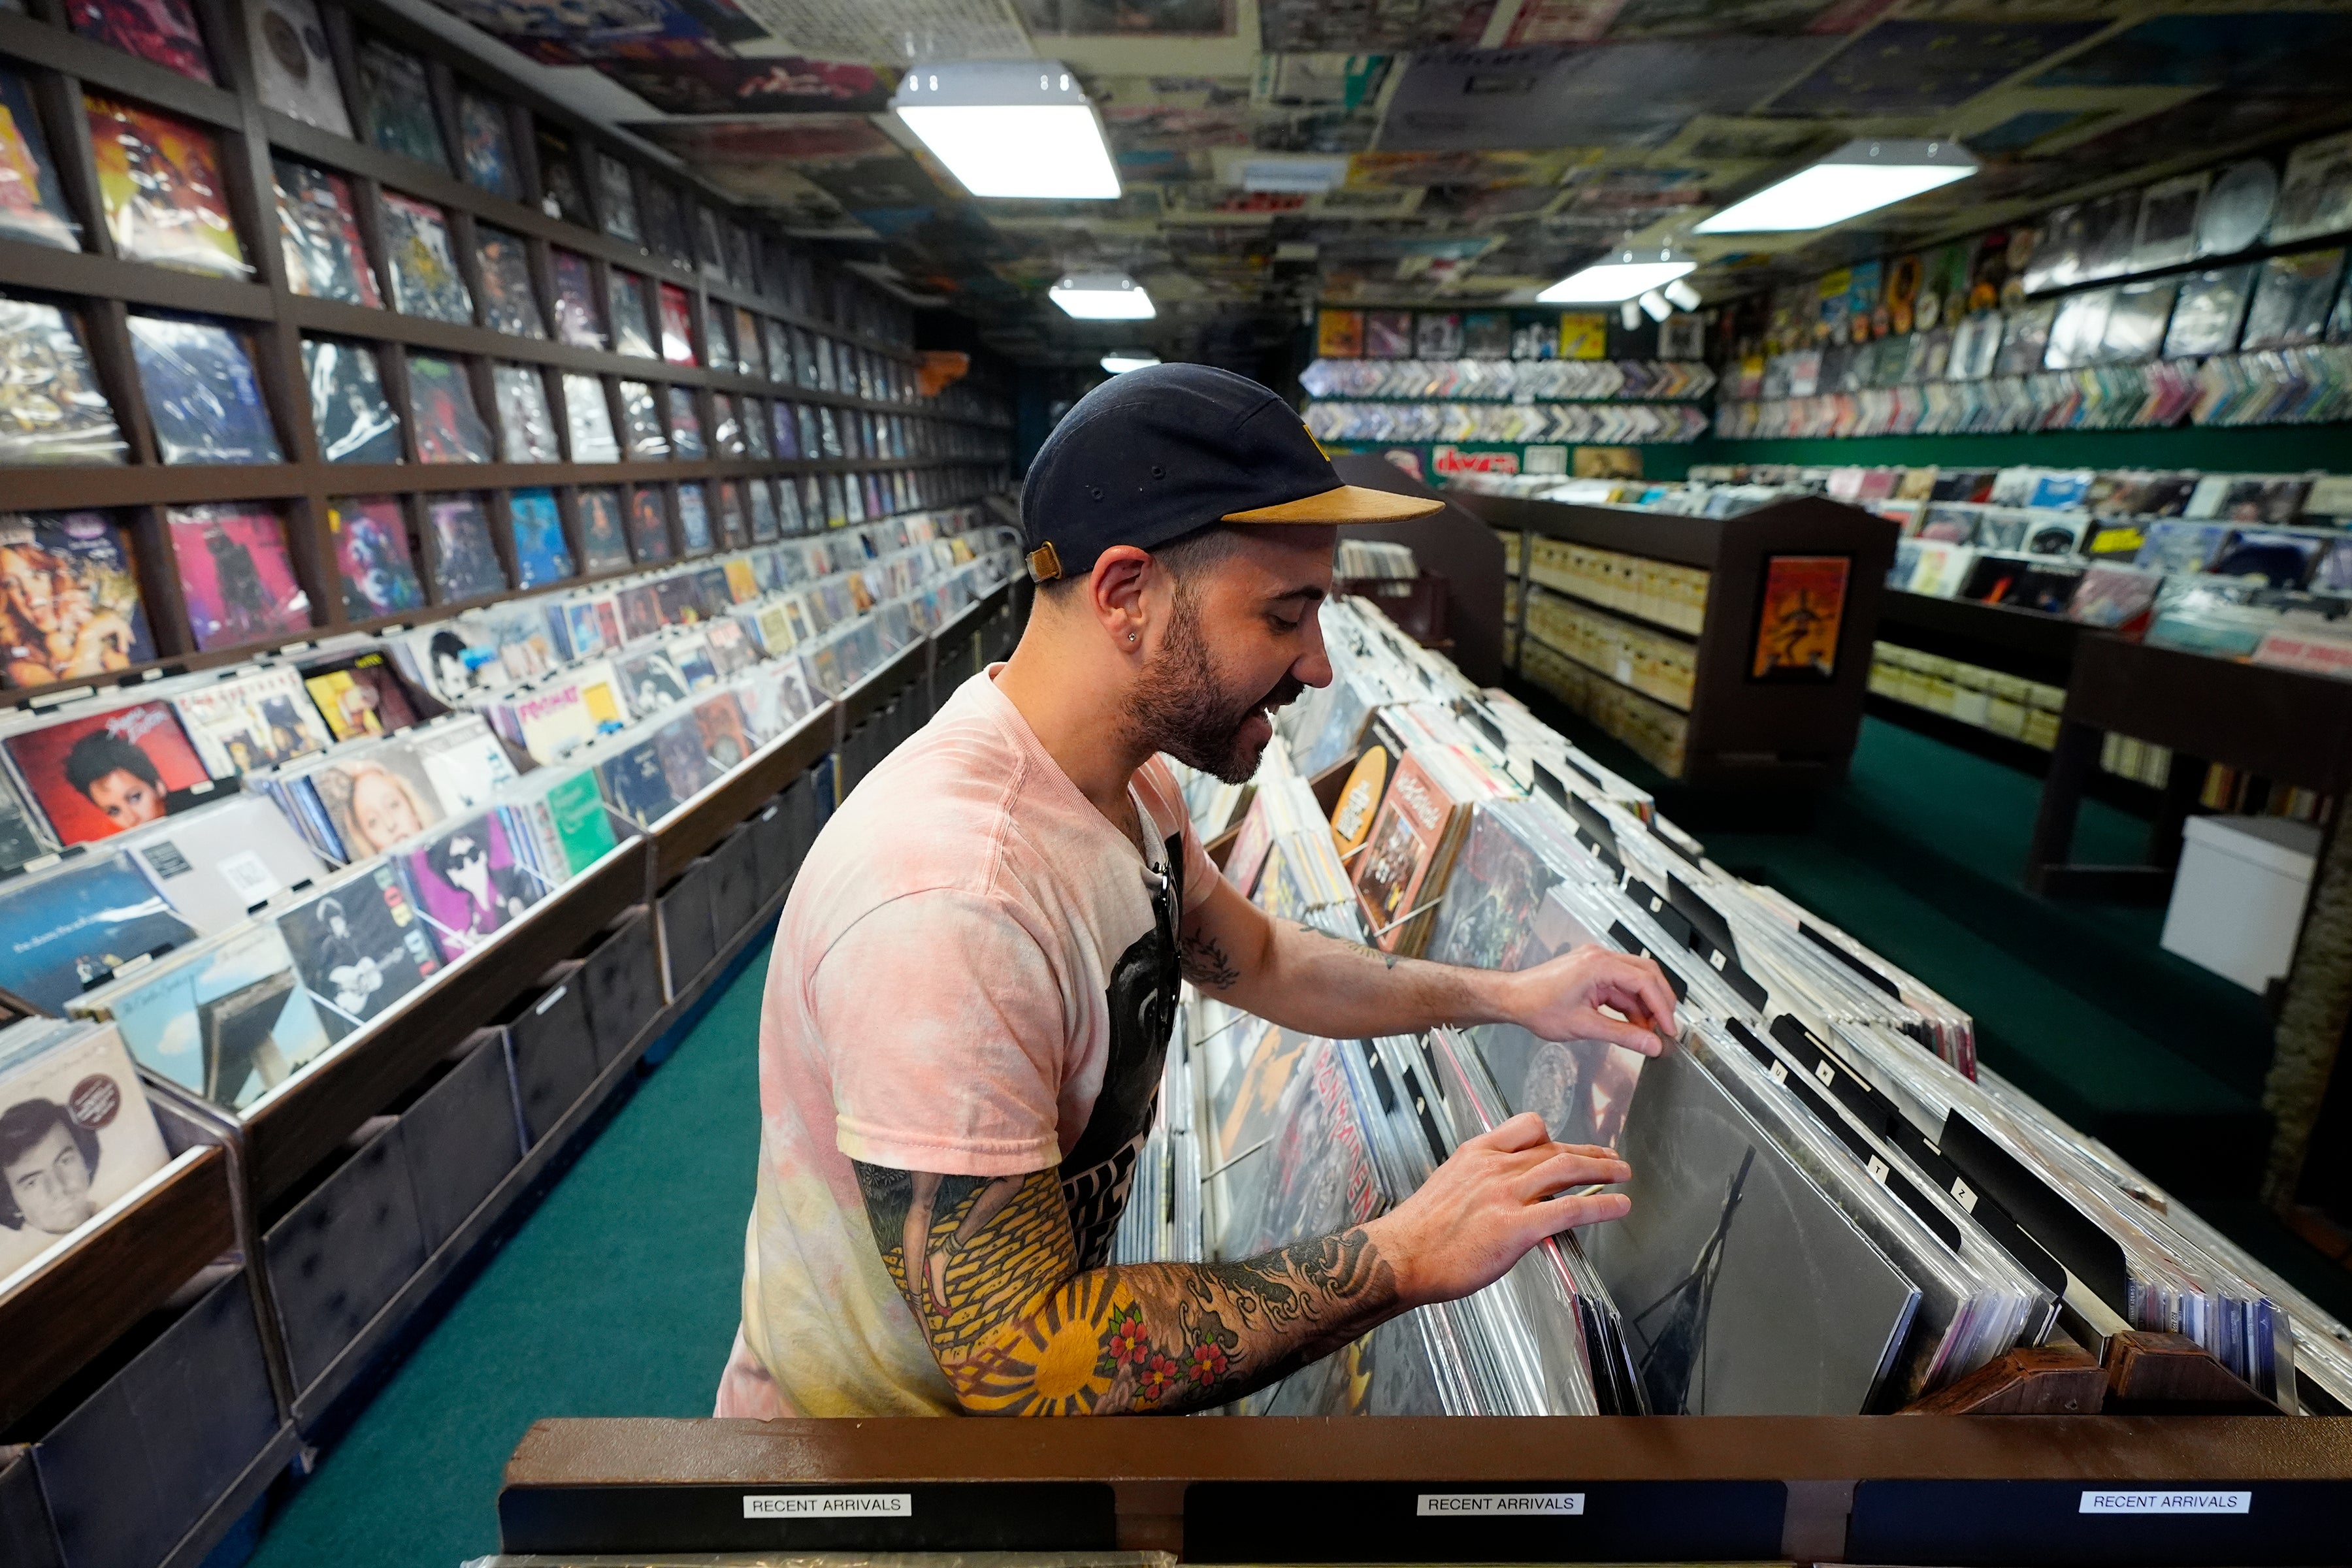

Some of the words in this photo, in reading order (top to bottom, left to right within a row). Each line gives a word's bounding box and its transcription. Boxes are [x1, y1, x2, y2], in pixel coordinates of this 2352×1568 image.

[1328, 1091, 1379, 1226] MAIDEN
[1875, 1166, 1881, 1174] T
[1958, 1188, 1966, 1198] Z
[753, 1499, 817, 1512] RECENT
[823, 1499, 902, 1512] ARRIVALS
[1428, 1498, 1493, 1511] RECENT
[1497, 1497, 1574, 1510] ARRIVALS
[2093, 1495, 2157, 1508] RECENT
[2161, 1495, 2238, 1508] ARRIVALS
